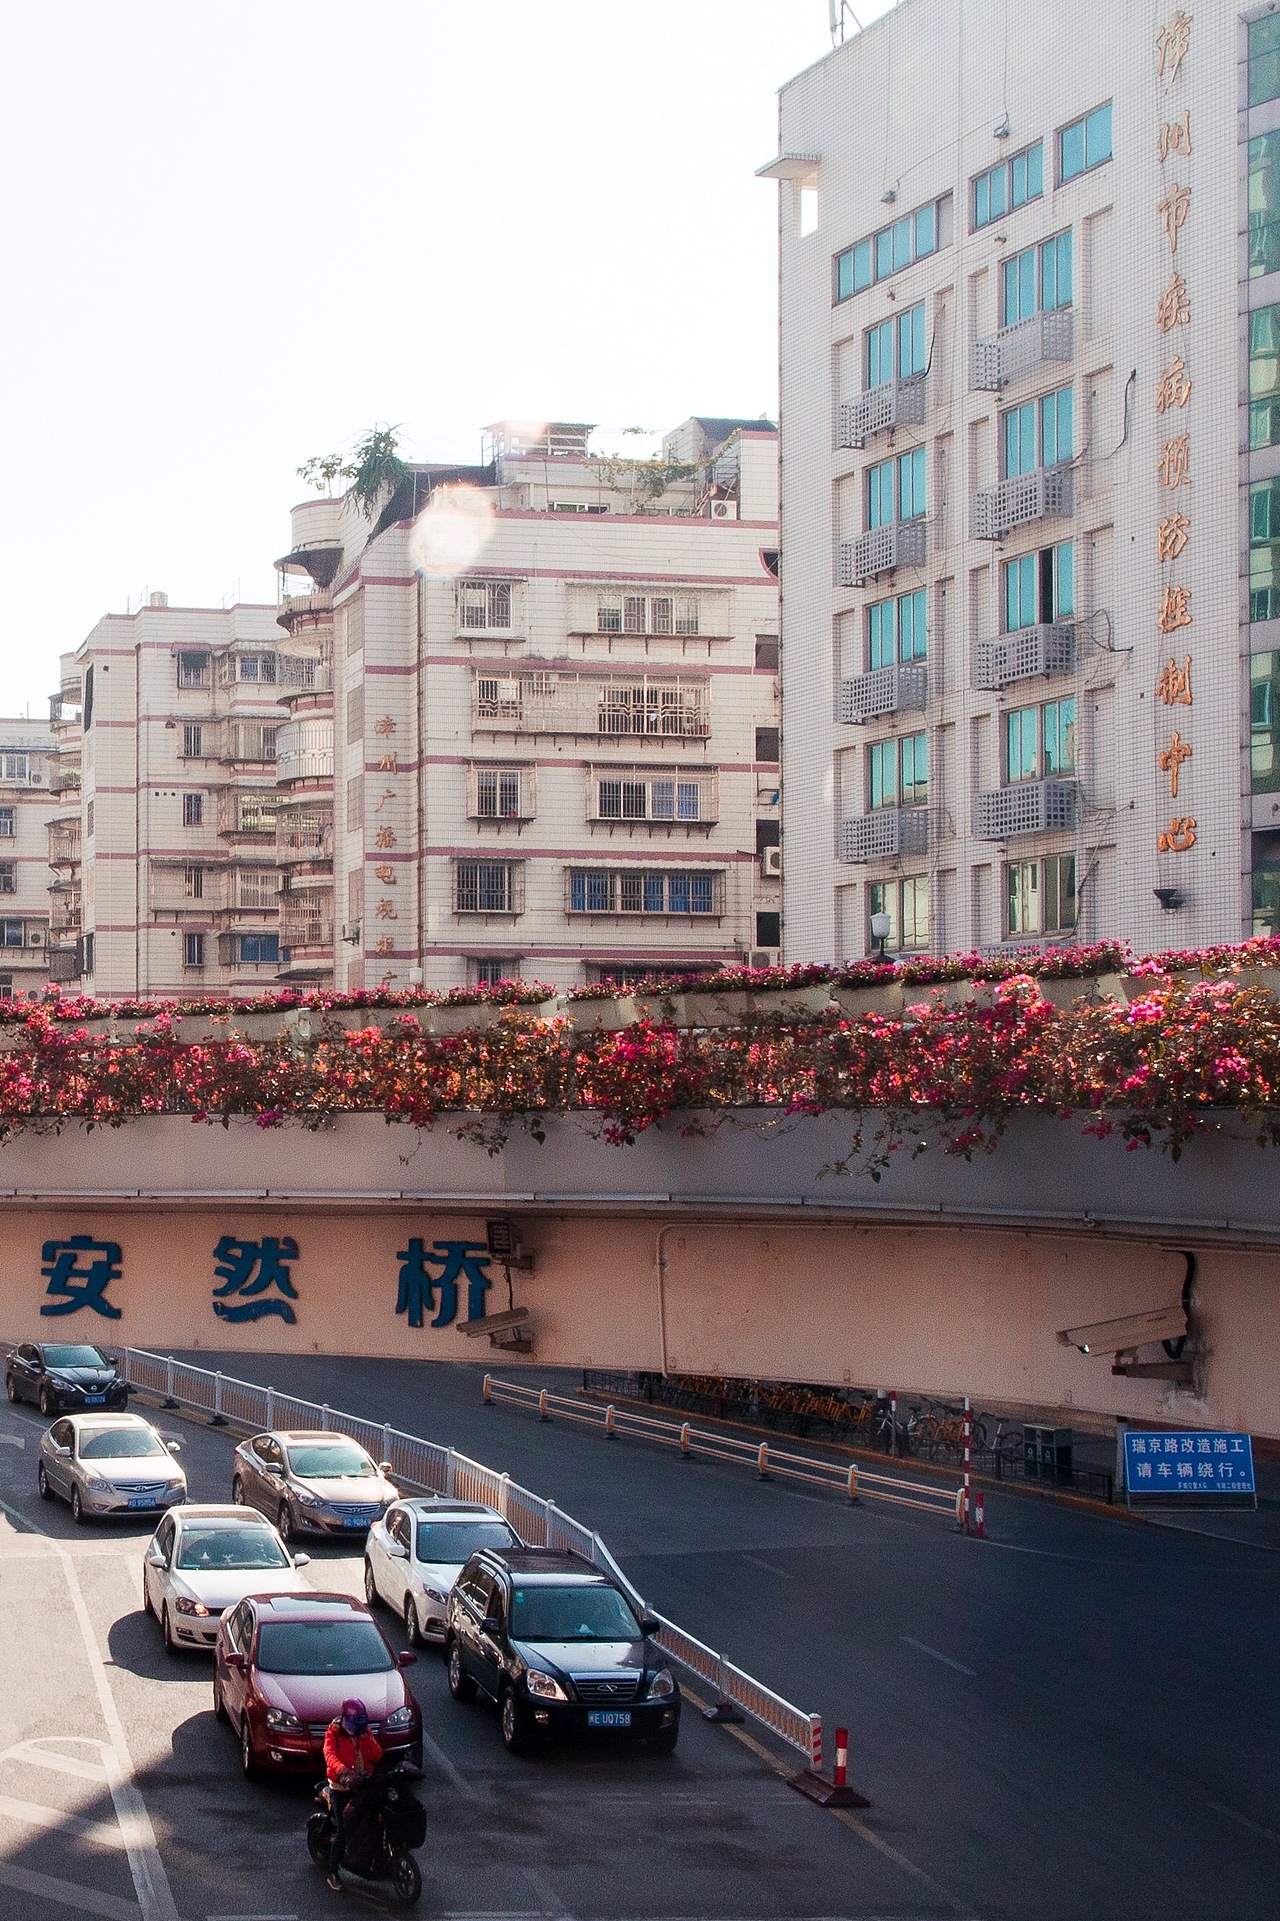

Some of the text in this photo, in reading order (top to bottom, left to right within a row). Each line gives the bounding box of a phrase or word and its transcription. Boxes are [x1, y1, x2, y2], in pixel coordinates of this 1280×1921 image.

[1156, 10, 1198, 852] 漳州市疾病预防控制中心
[39, 1235, 492, 1328] 安然桥
[1131, 1438, 1245, 1454] 瑞京路改造施工
[1136, 1462, 1246, 1479] 请车辆绕行。
